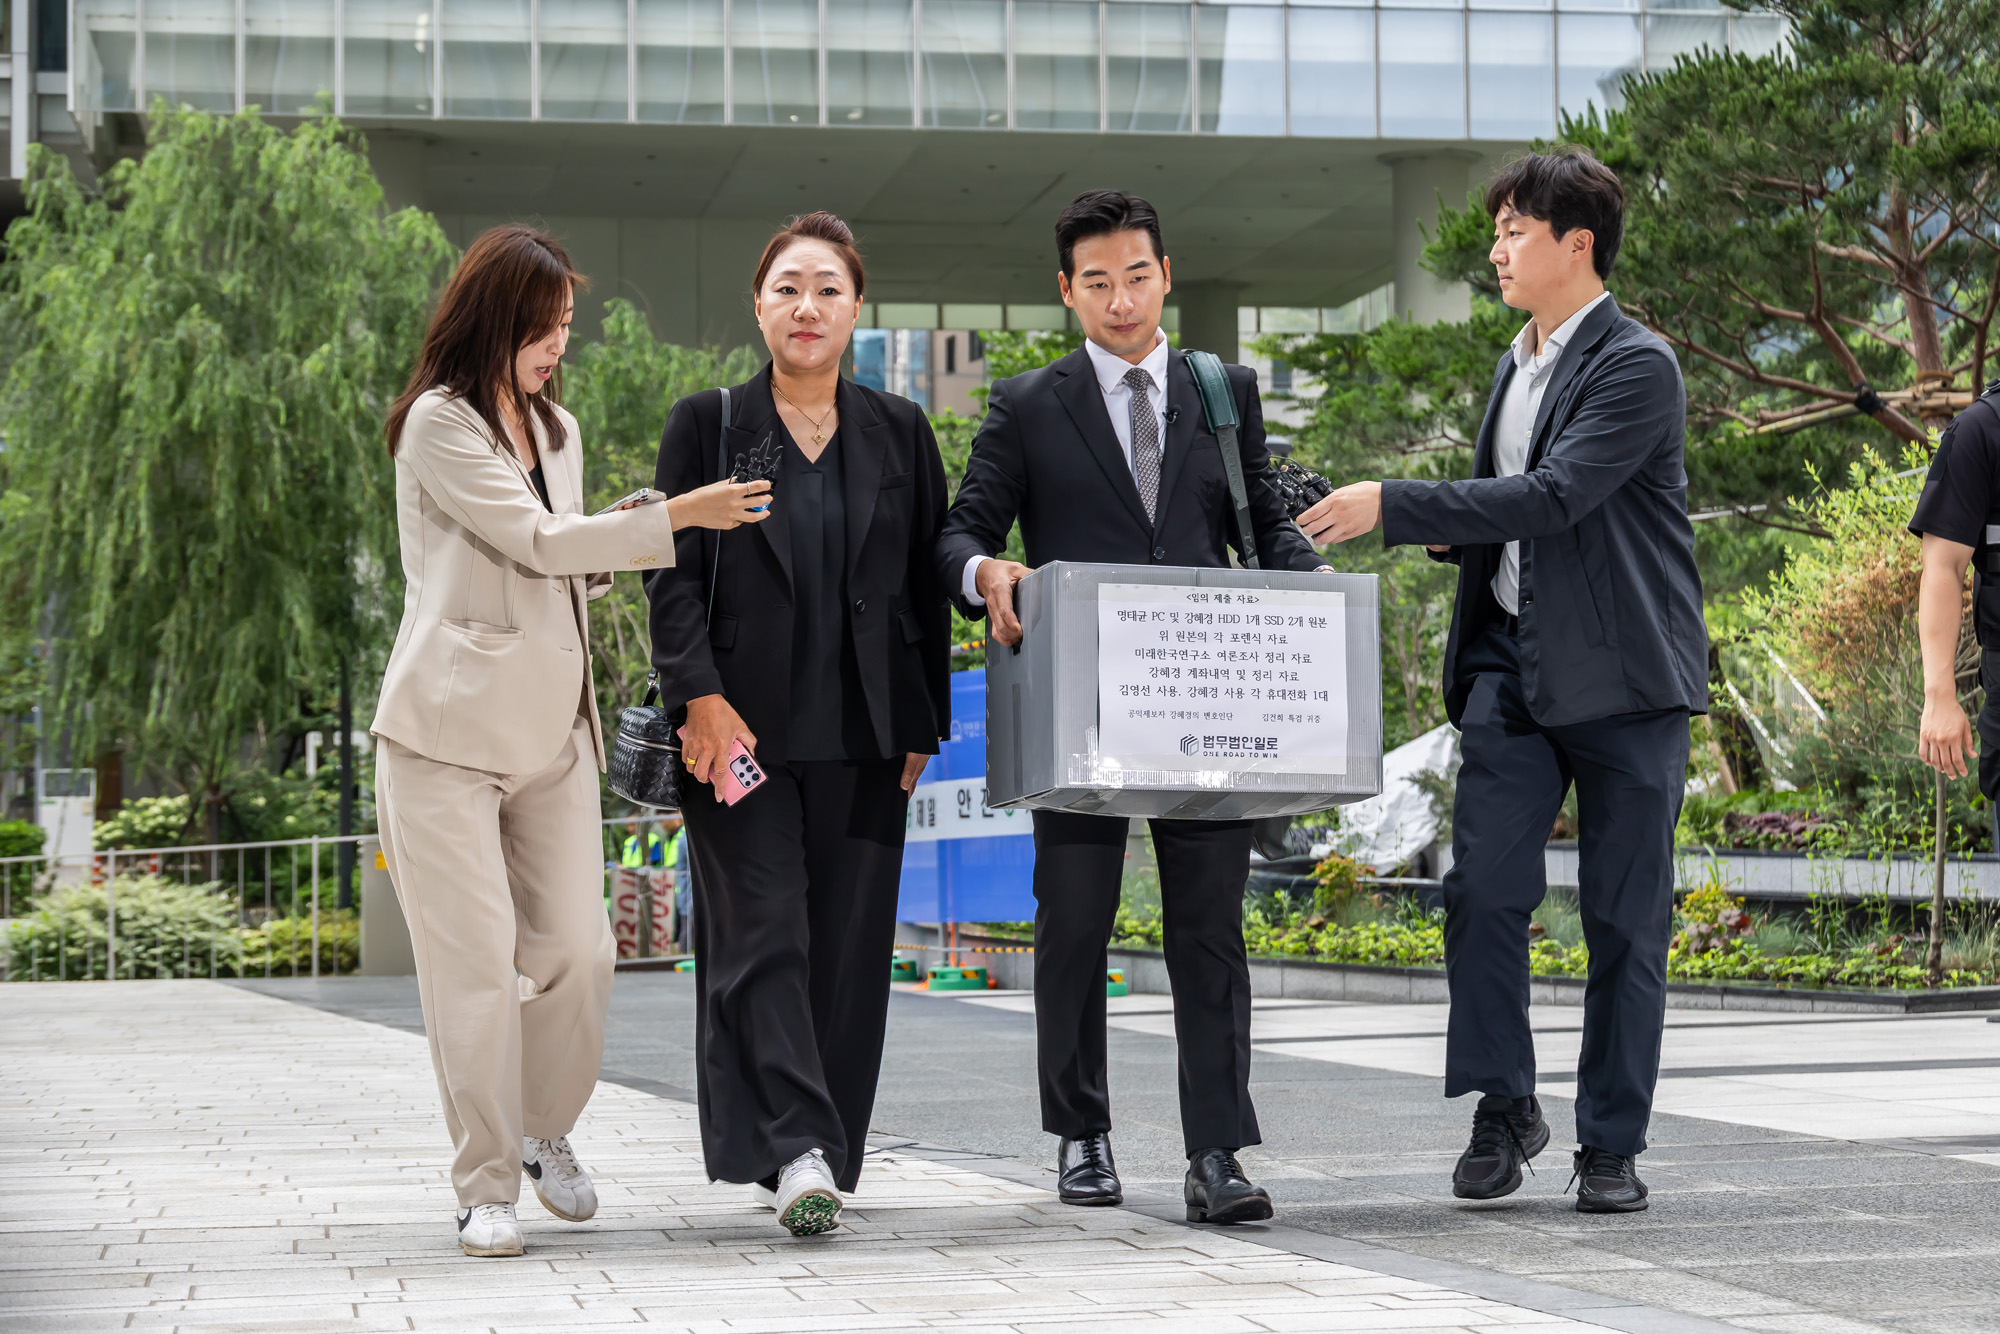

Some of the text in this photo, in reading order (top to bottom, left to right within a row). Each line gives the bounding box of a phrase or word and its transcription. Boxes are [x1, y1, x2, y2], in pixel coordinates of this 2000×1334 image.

[1186, 593, 1260, 604] <임의 제출 자료>
[1117, 610, 1328, 629] 명태균 PC 및 강혜경 HDD 1개 SSD 2개 원본
[1159, 630, 1288, 645] 위 원본의 각 포렌식 자료
[1135, 648, 1312, 664] 미래한국연구소 여론조사 정리 자료
[1148, 666, 1300, 682] 강혜경 계좌내역 및 정리 자료
[1119, 684, 1151, 697] 김영선
[1187, 686, 1218, 699] 강혜경
[1224, 687, 1245, 699] 사용
[1250, 687, 1261, 700] 각
[1266, 688, 1307, 701] 휴대전화
[1313, 690, 1328, 702] 1대
[1128, 709, 1234, 721] 공익제보자 강혜경의 변호인단
[1262, 713, 1321, 724] 김건희 특검 귀중
[1203, 735, 1278, 750] 법무법인일로
